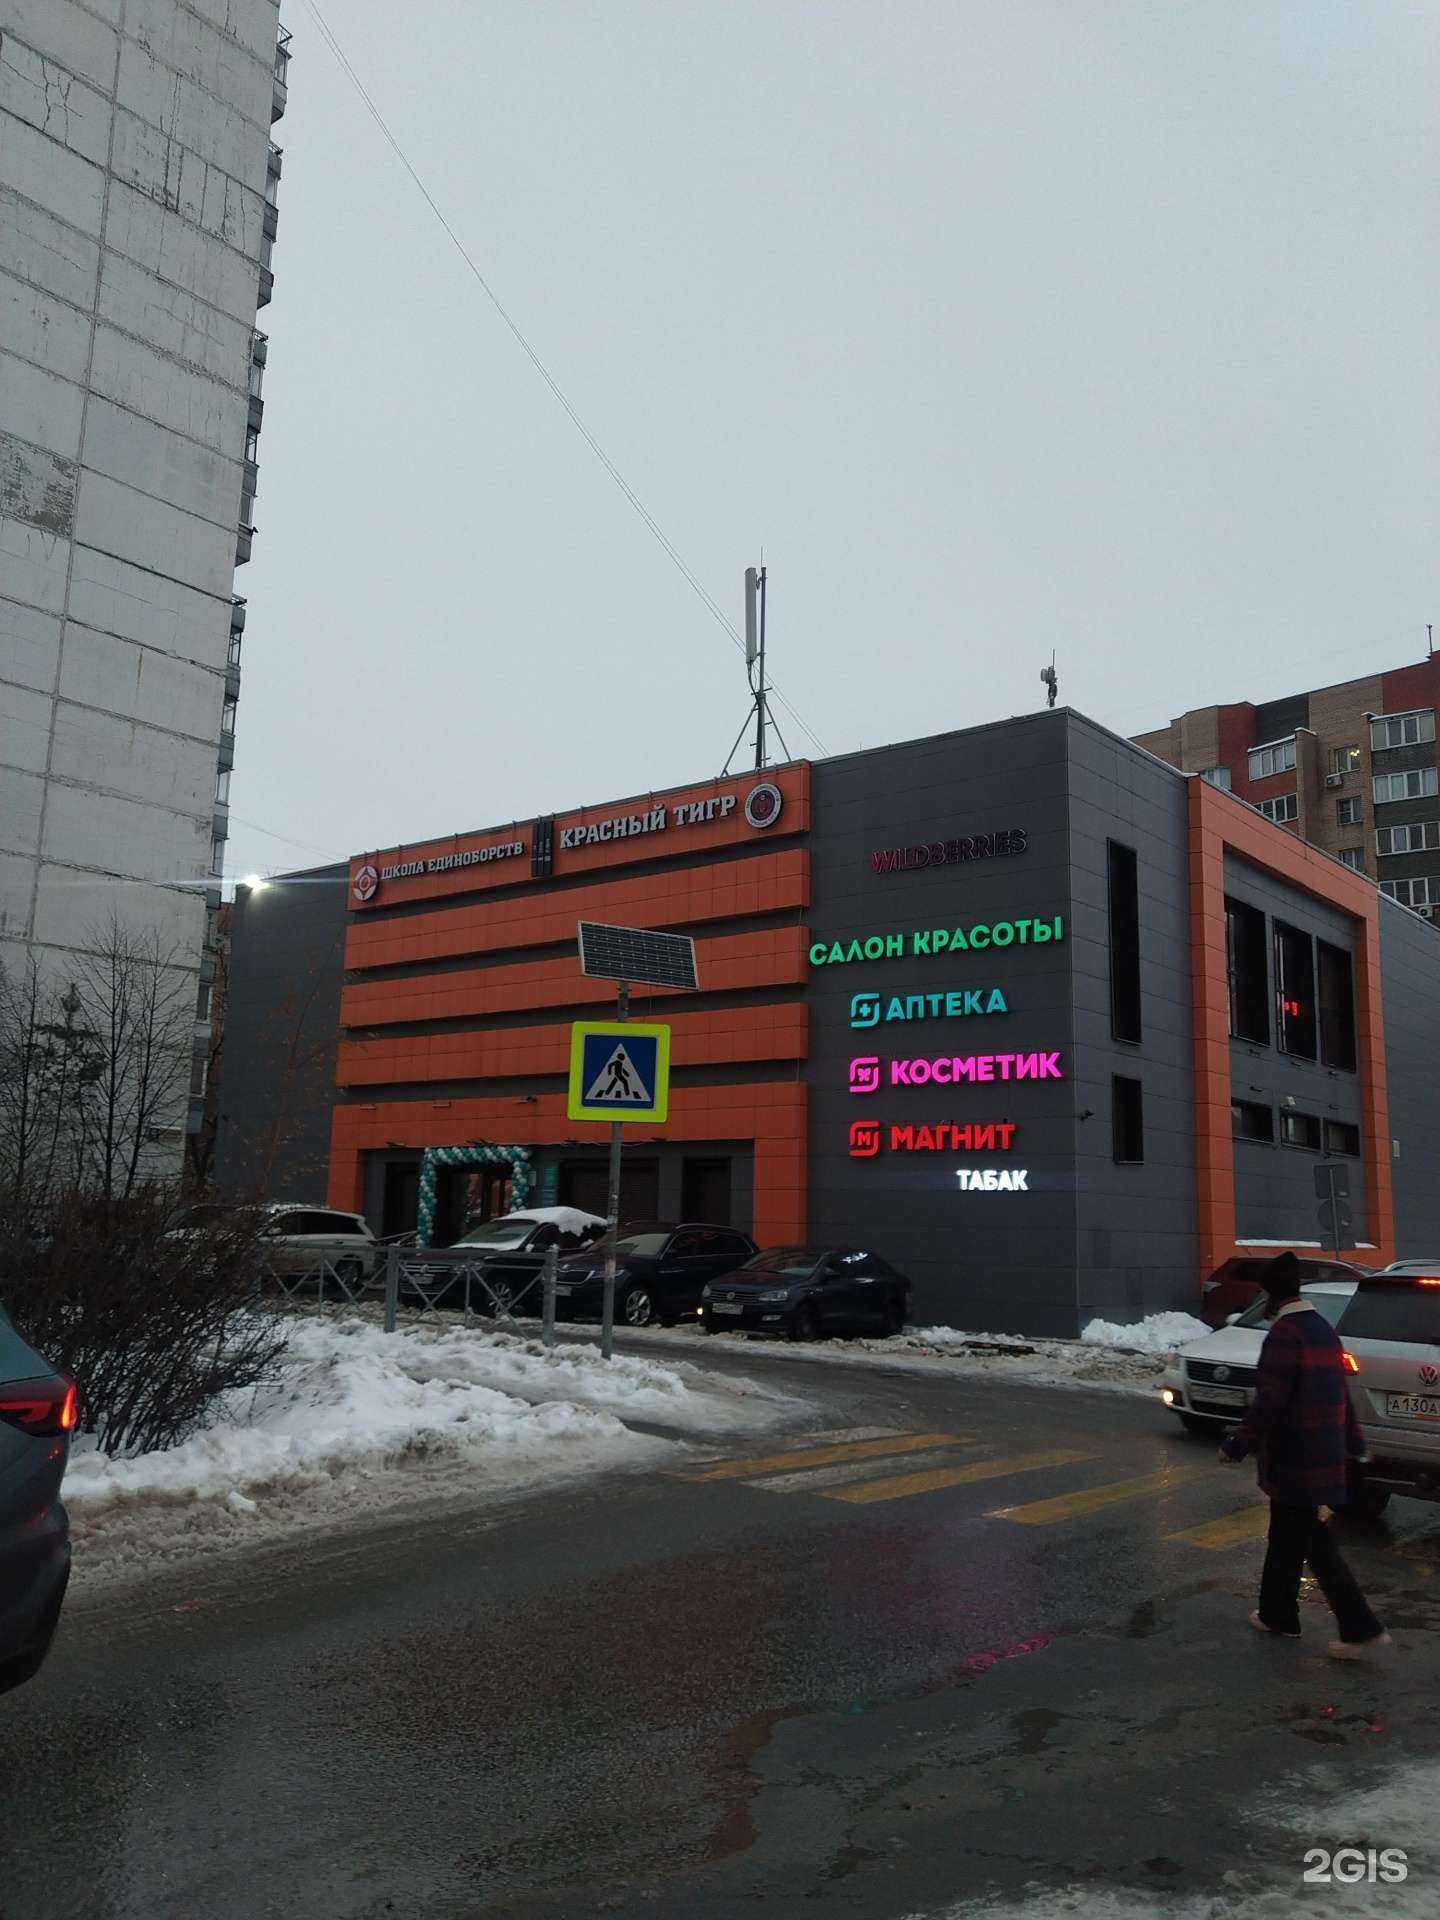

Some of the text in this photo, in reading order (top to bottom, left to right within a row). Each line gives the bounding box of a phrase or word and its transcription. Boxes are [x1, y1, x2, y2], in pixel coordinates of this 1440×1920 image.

[560, 803, 666, 849] КРАСНЫЙ
[673, 795, 736, 826] ТИГР
[381, 841, 523, 880] ШКОЛА ЕДИНОБОРСТВ
[870, 828, 1027, 873] WILDBERRIES
[809, 916, 1063, 966] САЛОН КРАСОТЫ
[886, 988, 1008, 1021] АПТЕКА
[890, 1051, 1063, 1085] КОСМЕТИК
[891, 1123, 1016, 1150] МАГНИТ
[956, 1169, 1029, 1191] ТАБАК
